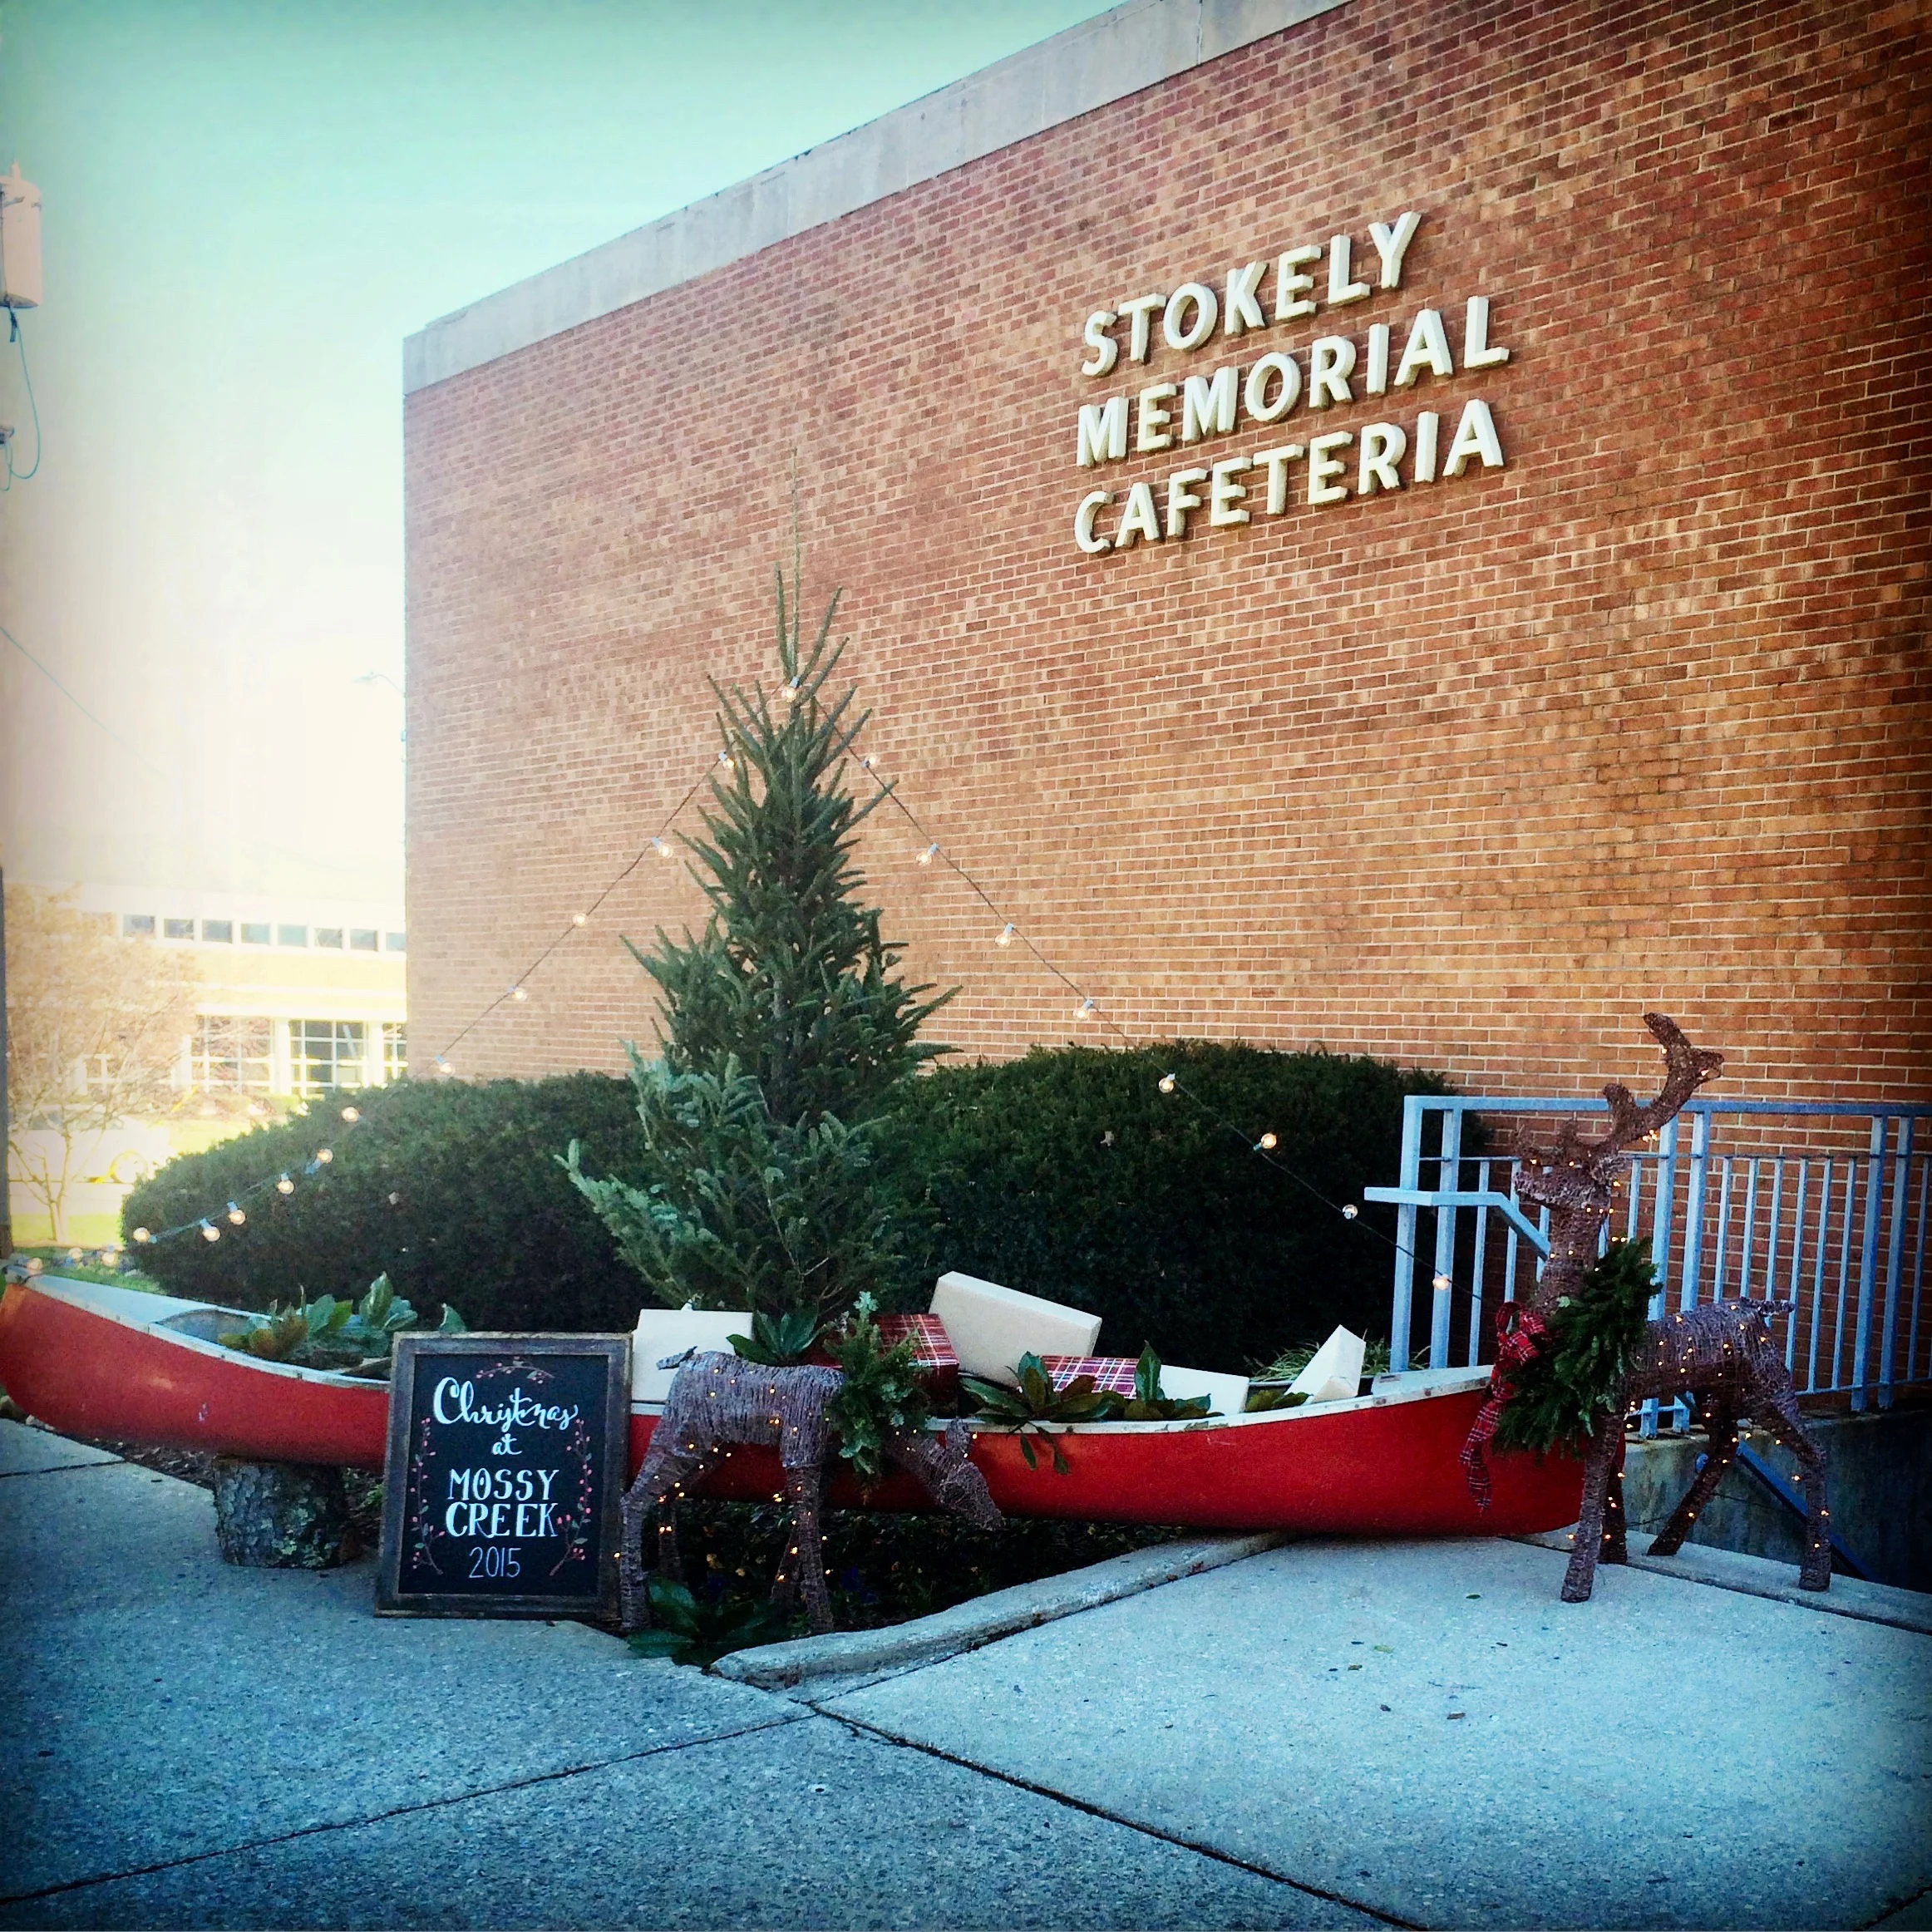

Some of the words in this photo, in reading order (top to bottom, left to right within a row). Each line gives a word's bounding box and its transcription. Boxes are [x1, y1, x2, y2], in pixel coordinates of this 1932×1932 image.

[1082, 211, 1421, 377] STOKELY
[1077, 296, 1510, 467] MEMORIAL
[1074, 399, 1503, 554] CAFETERIA
[433, 1377, 579, 1432] Christmas
[491, 1433, 522, 1455] at
[447, 1468, 559, 1501] MOSSY
[446, 1501, 559, 1538] CREEK
[469, 1546, 521, 1578] 2015
